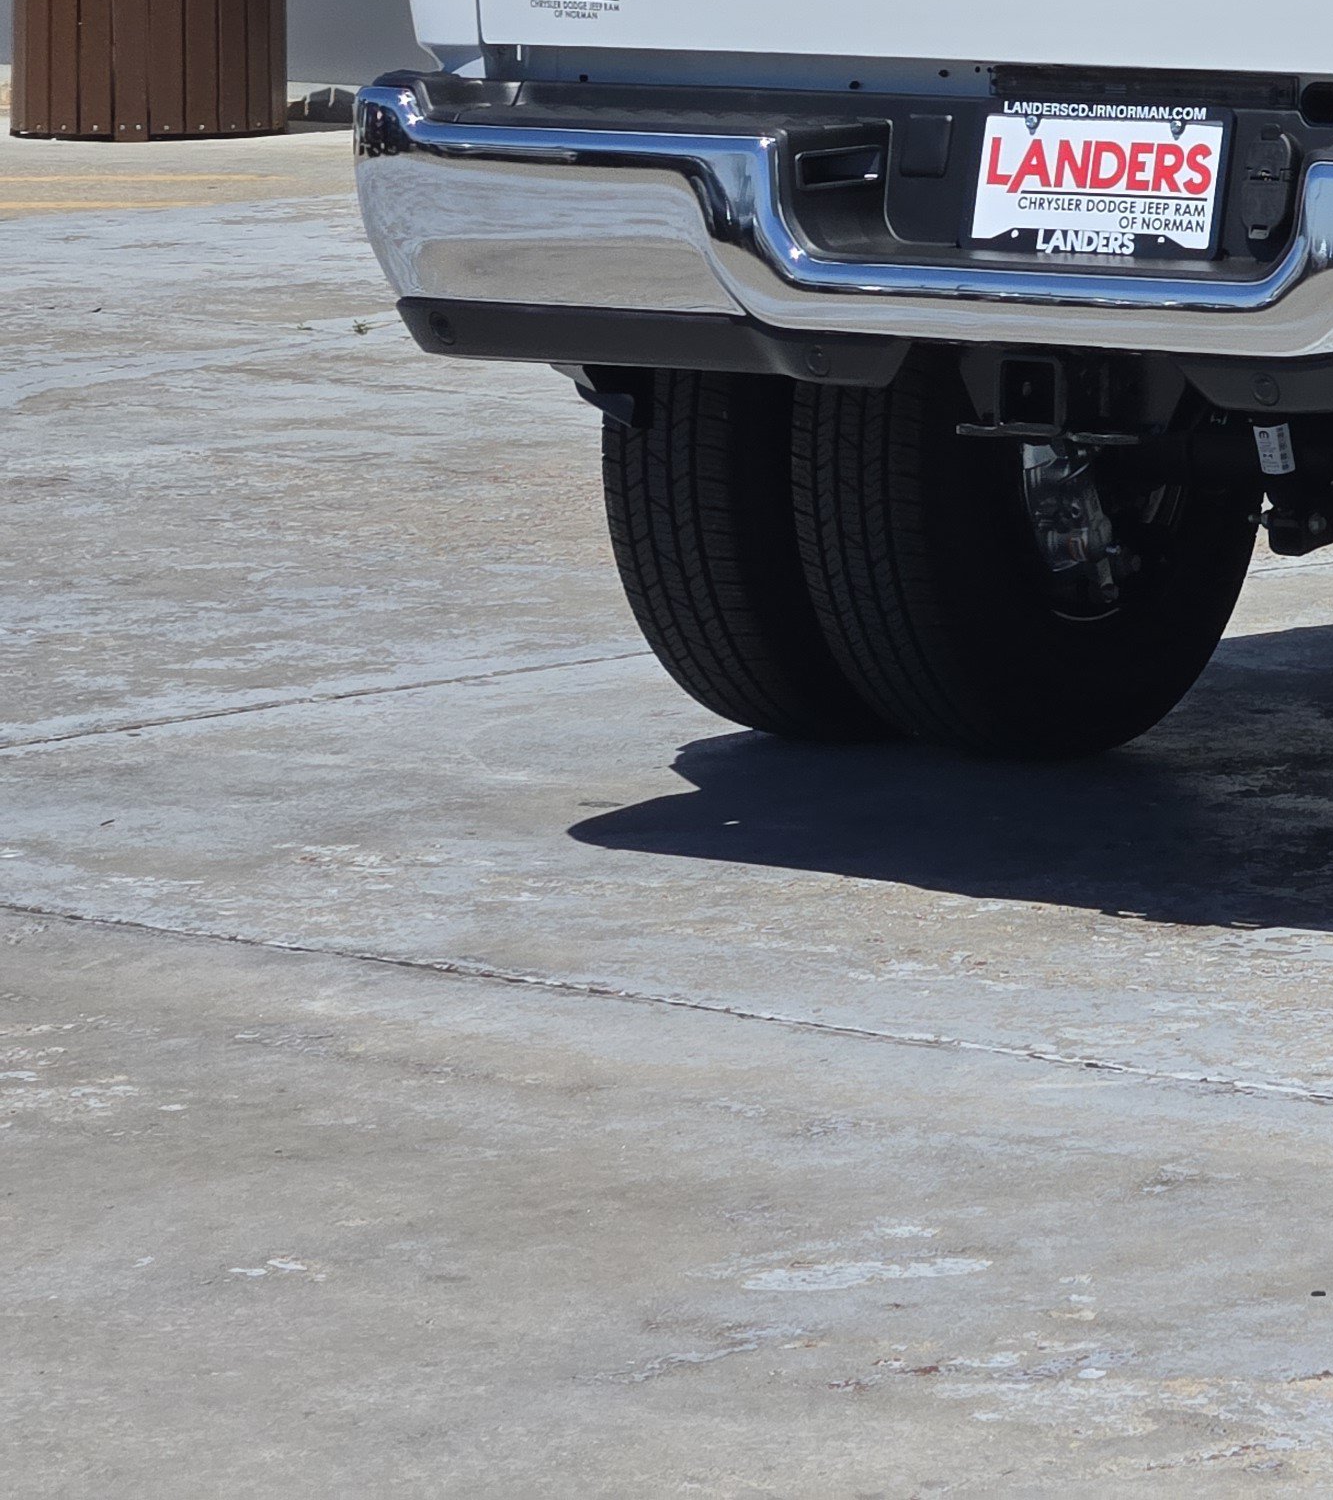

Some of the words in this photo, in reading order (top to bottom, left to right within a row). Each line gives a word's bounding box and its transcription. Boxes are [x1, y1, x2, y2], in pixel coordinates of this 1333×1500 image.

[530, 0, 561, 9] CHRYSLER
[563, 1, 587, 11] DODGE
[589, 2, 603, 11] JEEP
[604, 3, 620, 12] RAM
[1003, 100, 1207, 120] LANDERSCDJRNORMAN.COM
[986, 136, 1213, 195] LANDERS
[1017, 196, 1082, 212] CHRYSLER
[1086, 199, 1137, 214] DODGE
[1140, 201, 1170, 216] JEEP
[1173, 202, 1206, 218] RAM
[1118, 215, 1139, 230] OF
[1141, 216, 1205, 233] NORMAN
[1036, 228, 1135, 256] LANDERS
